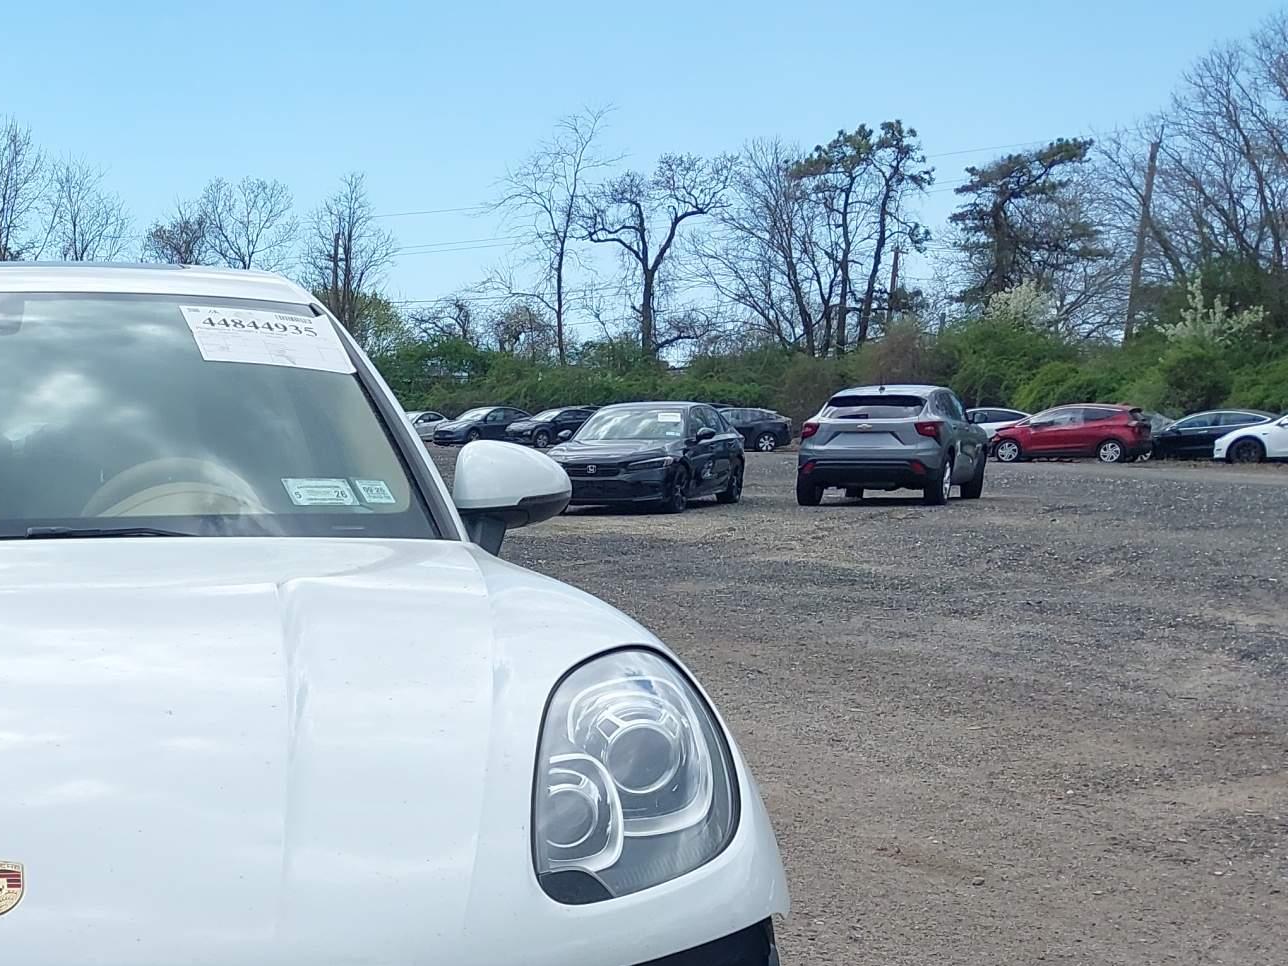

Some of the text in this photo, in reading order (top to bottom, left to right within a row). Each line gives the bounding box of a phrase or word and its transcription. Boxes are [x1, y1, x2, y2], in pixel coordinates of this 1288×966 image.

[202, 316, 318, 337] 44844935
[294, 490, 348, 499] 5 26
